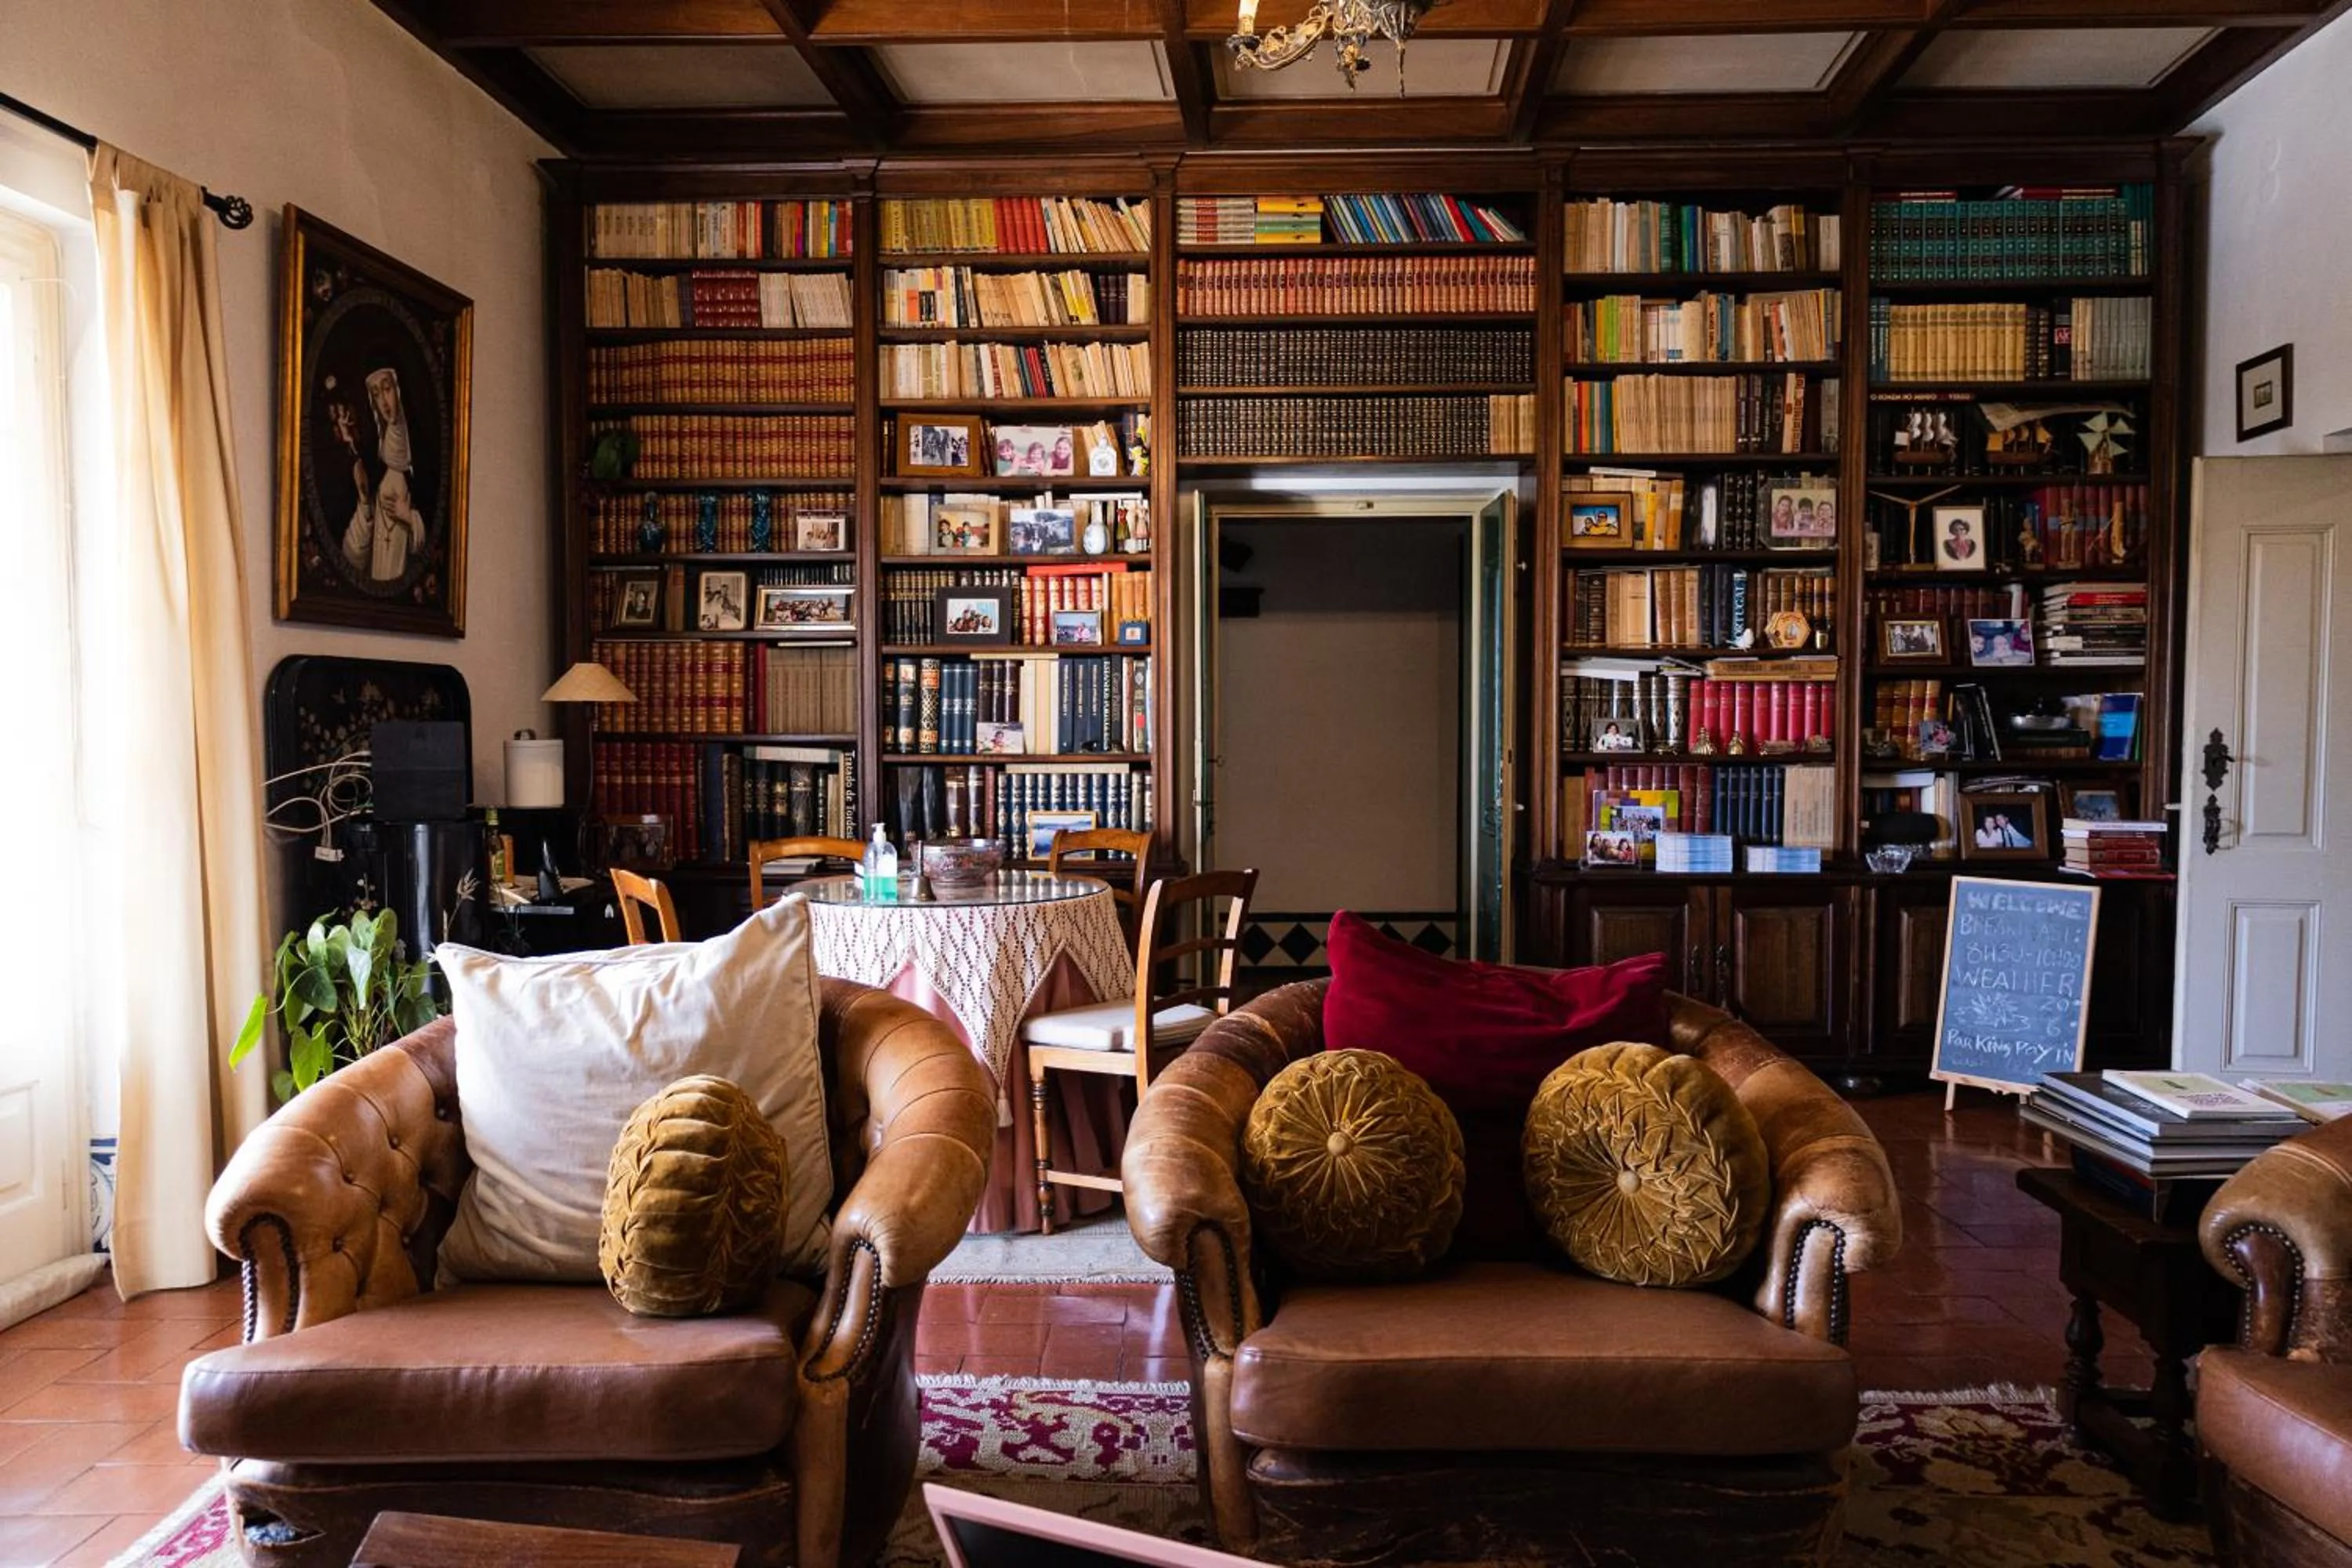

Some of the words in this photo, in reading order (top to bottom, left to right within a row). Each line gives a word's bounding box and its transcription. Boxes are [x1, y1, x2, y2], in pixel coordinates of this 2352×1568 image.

[1733, 586, 1744, 642] ORTUGAL
[844, 750, 856, 788] Tratado
[846, 789, 856, 802] de
[1955, 965, 2076, 997] WEATHER
